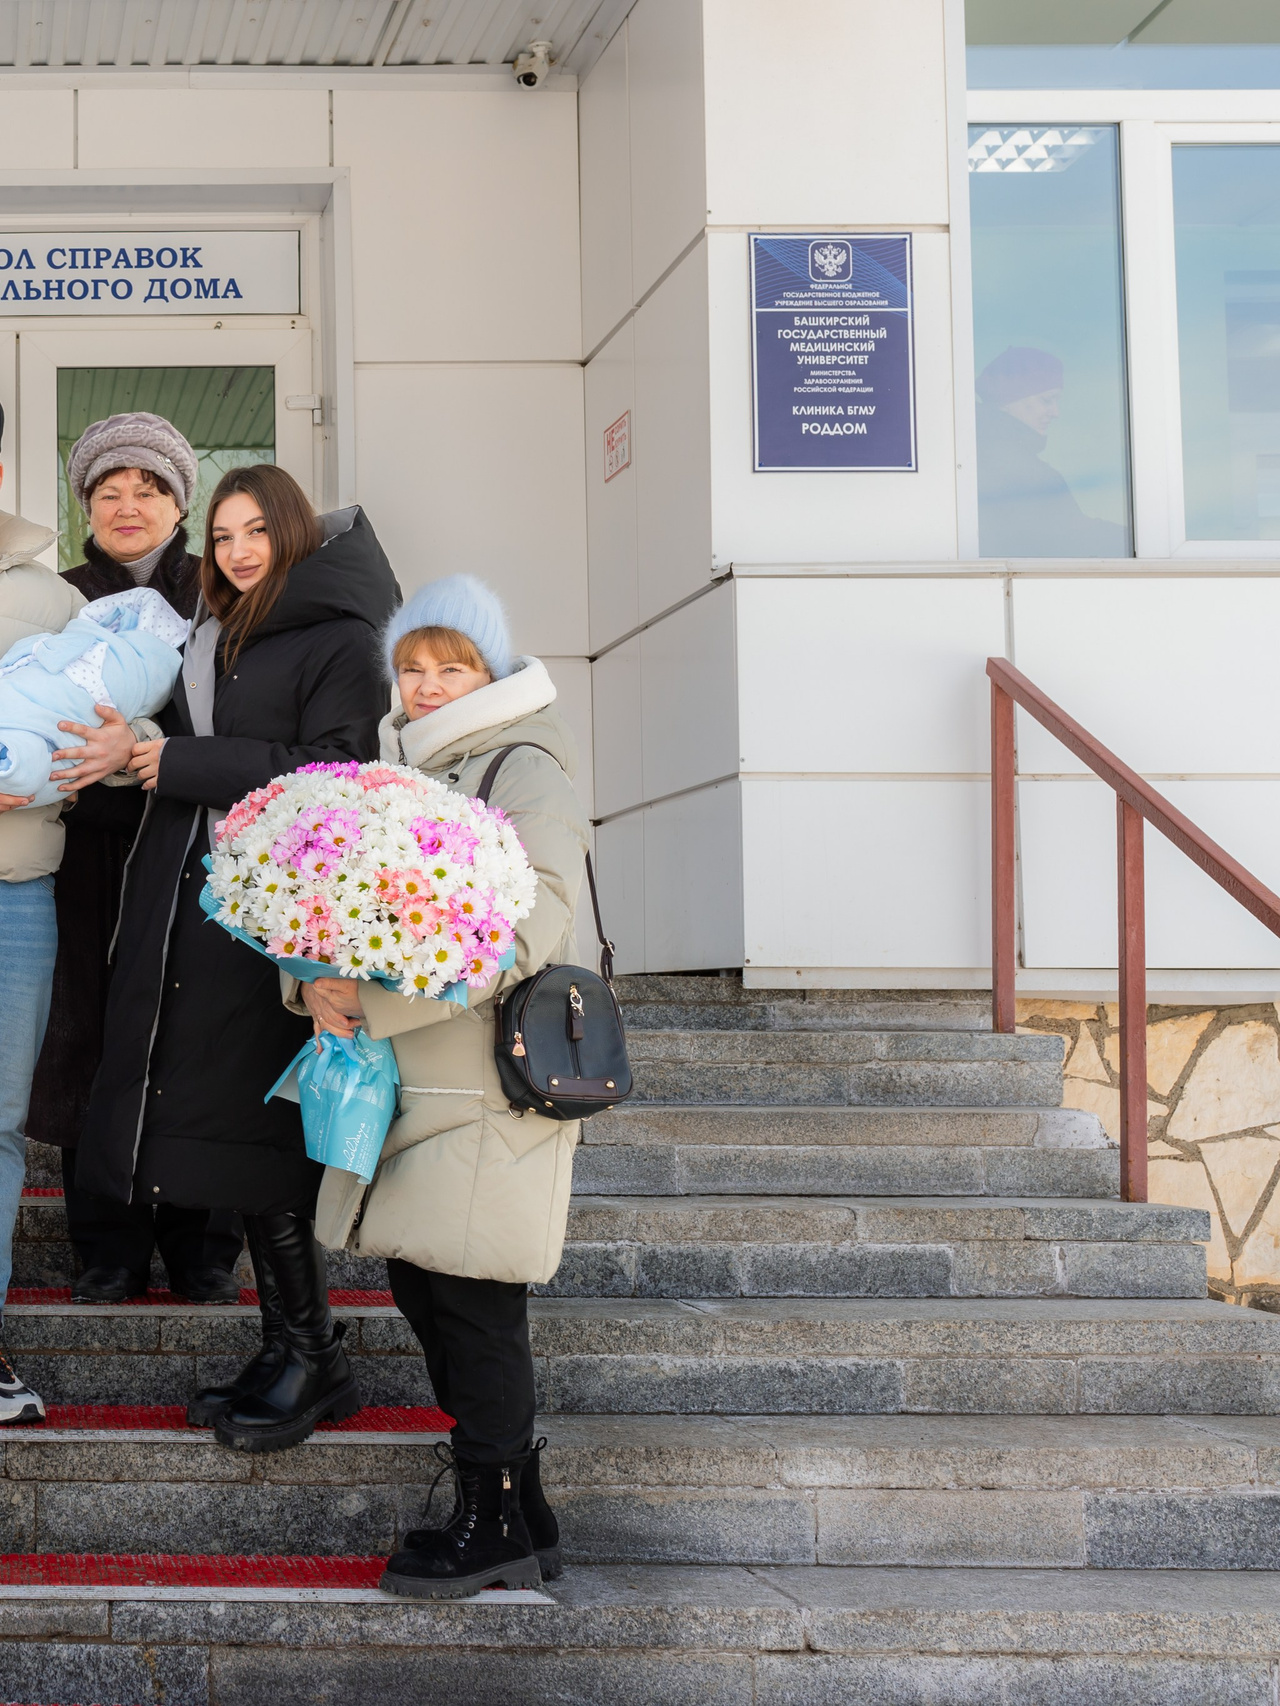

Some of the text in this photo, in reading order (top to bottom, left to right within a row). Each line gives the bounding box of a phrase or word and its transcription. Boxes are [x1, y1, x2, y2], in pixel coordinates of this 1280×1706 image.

[46, 246, 203, 270] СПРАВОК
[143, 277, 243, 304] ДОМА
[783, 291, 880, 299] ГОСУДАРСТВЕННОЕ БЮДЖЕТНОЕ
[794, 314, 870, 326] БАШКИРСКИЙ
[777, 327, 887, 341] ГОСУДАРСТВЕННЫЙ
[790, 340, 875, 353] МЕДИЦИНСКИЙ
[796, 355, 869, 365] УНИВЕРСИТЕТ
[793, 386, 874, 394] РОССИЙСКОЙ ФЕДЕРАЦИИ
[792, 405, 876, 416] КЛИНИКА БГМУ
[802, 423, 867, 436] РОДДОМ
